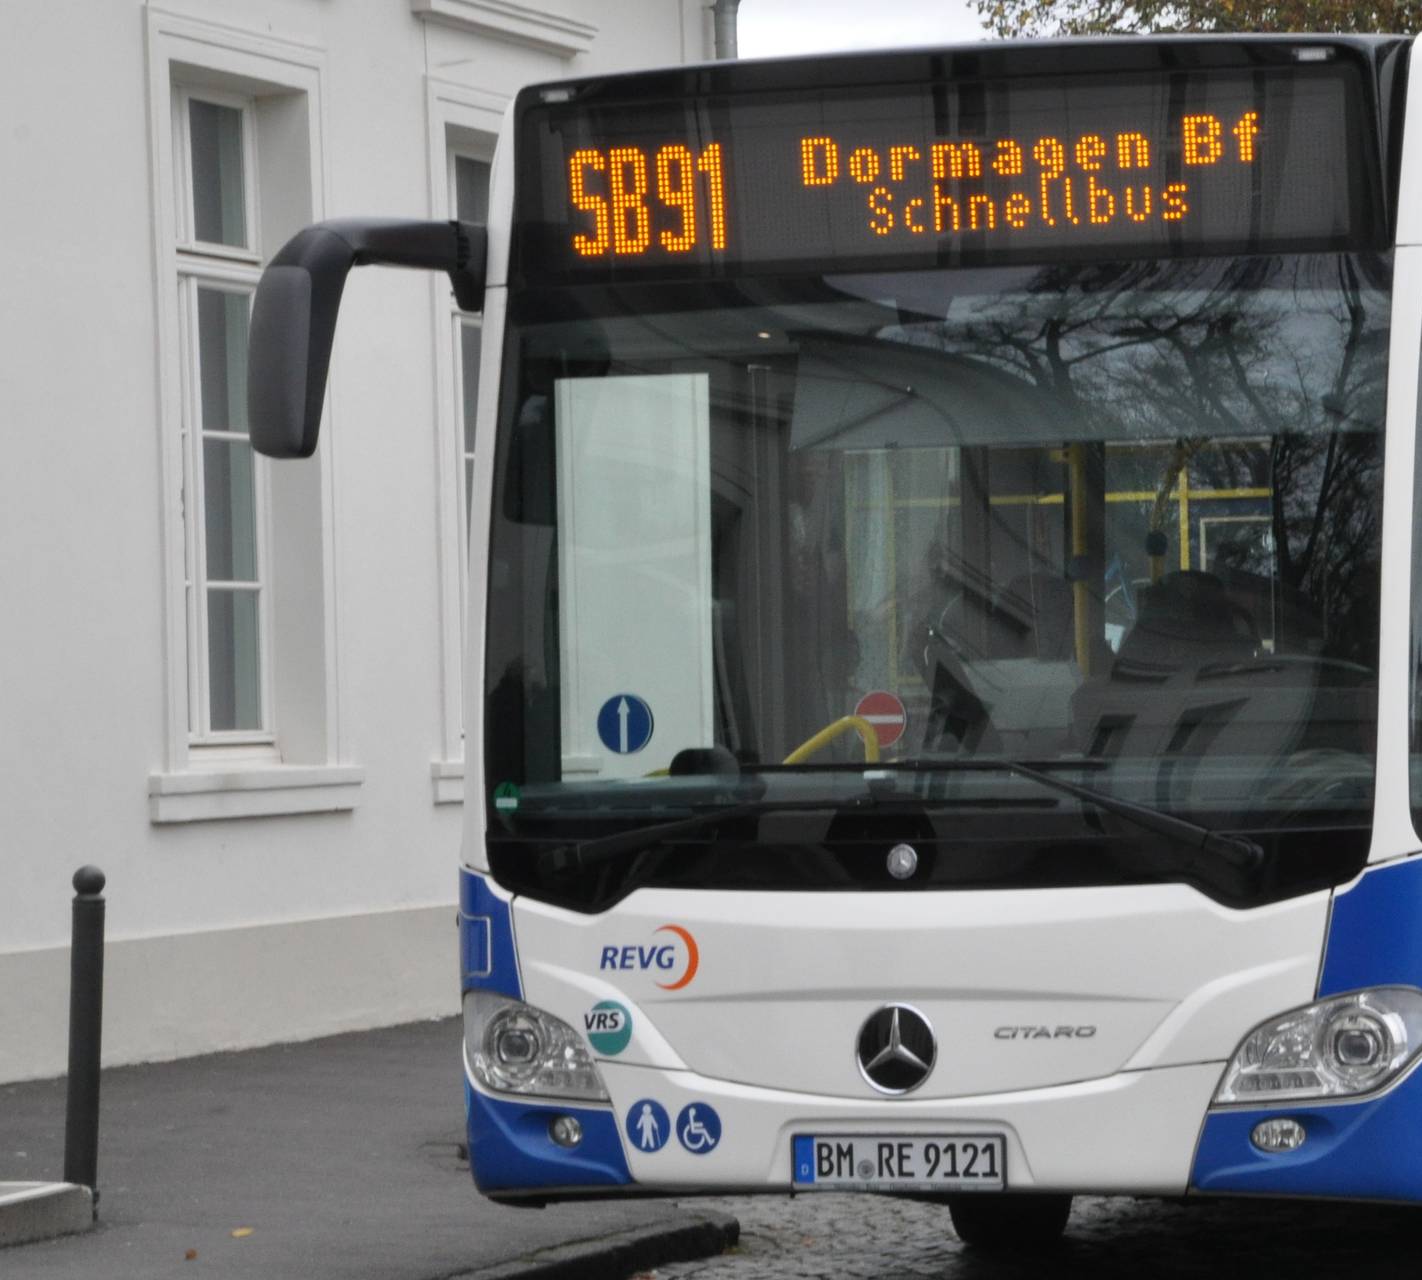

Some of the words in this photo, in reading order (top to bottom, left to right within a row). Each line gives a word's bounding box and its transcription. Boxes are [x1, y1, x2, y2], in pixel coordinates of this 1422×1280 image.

[801, 132, 1152, 187] Dormagen
[1182, 112, 1260, 165] Bf
[569, 142, 727, 257] SB91
[868, 174, 1190, 235] Schnellbus
[600, 945, 676, 970] REVG
[584, 1012, 620, 1031] VRS
[993, 1025, 1097, 1040] CITARO
[816, 1142, 854, 1178] BM
[877, 1142, 915, 1178] RE
[923, 1142, 999, 1178] 9121
